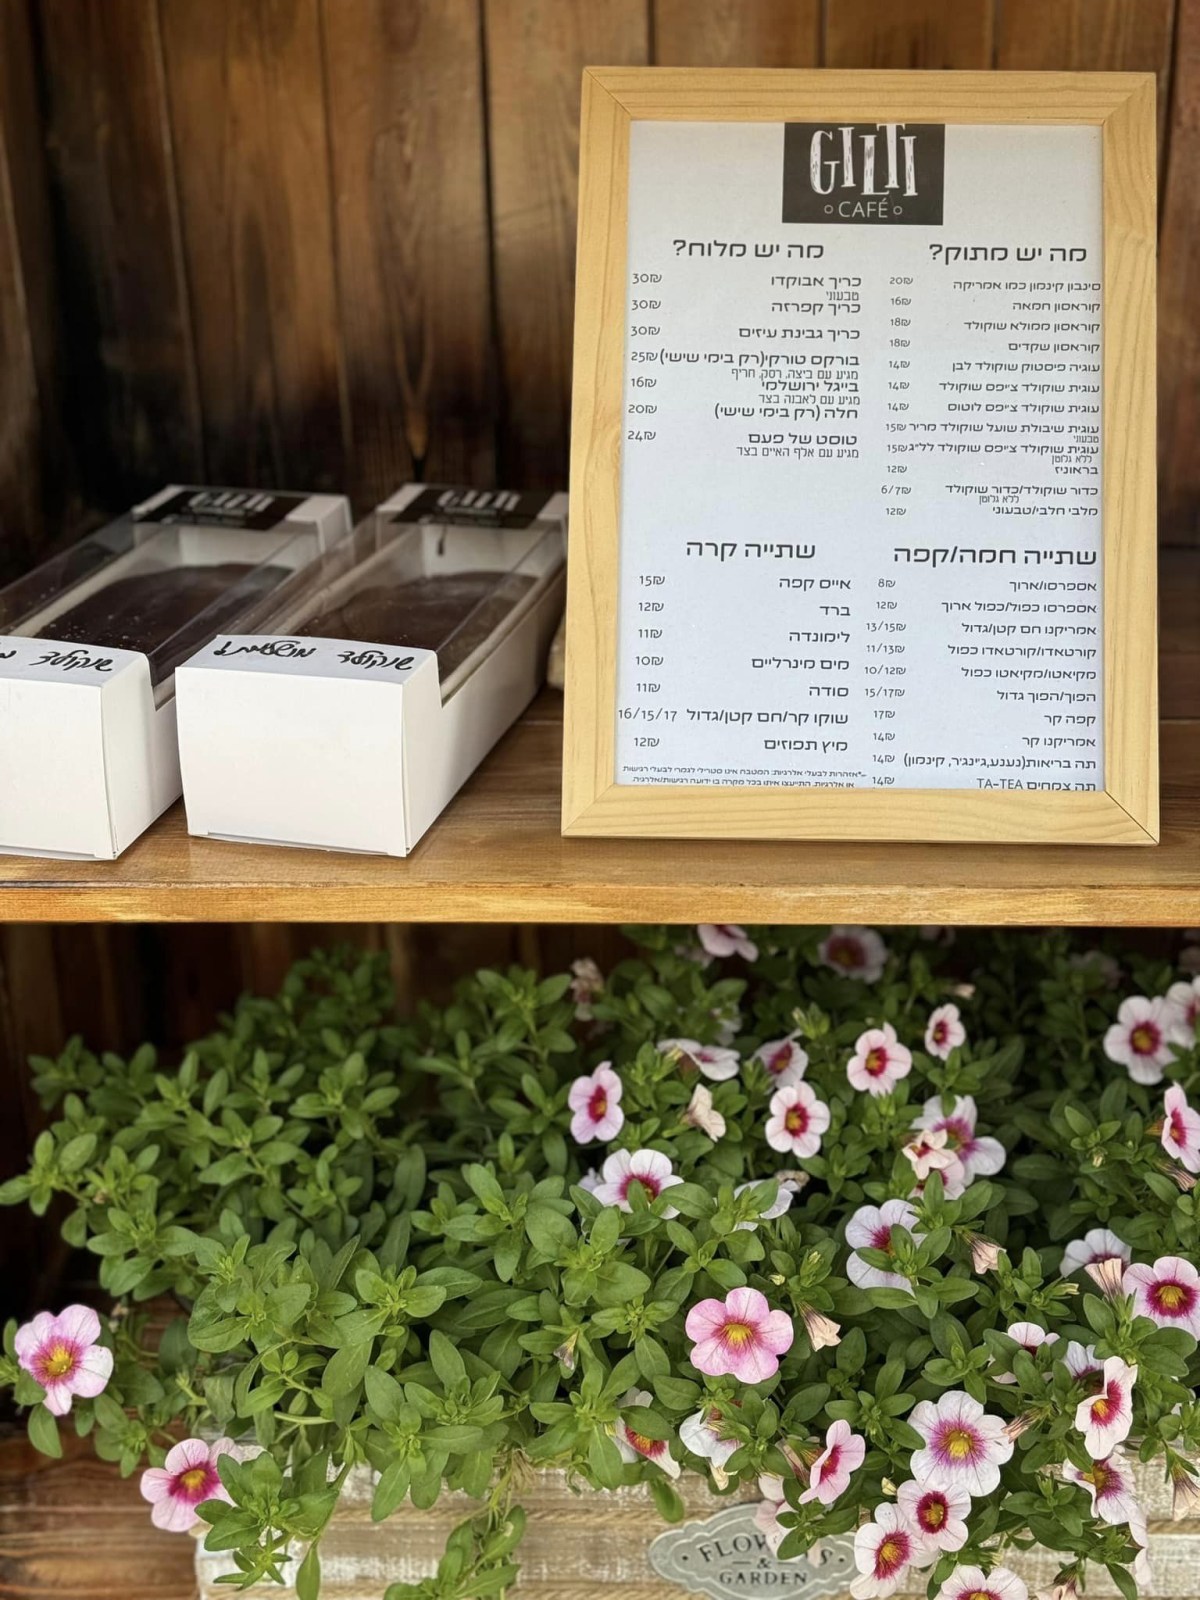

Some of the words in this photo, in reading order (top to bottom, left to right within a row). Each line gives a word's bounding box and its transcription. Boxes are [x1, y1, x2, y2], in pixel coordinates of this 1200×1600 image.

[810, 123, 918, 196] GILTI
[838, 198, 889, 218] CAFÉ
[673, 239, 746, 257] מלוח?
[754, 244, 780, 258] יש
[787, 244, 824, 259] מה
[929, 244, 1008, 266] מתוק?
[1016, 247, 1042, 261] יש
[1050, 248, 1087, 262] מה
[771, 276, 824, 289] אבוקדו
[828, 277, 862, 290] כריך
[953, 281, 1002, 292] אמריקה
[1005, 282, 1026, 290] כמו
[1029, 282, 1064, 293] קינמון
[1067, 283, 1101, 293] סינבון
[772, 302, 824, 316] קפרזה
[828, 303, 861, 316] כריך
[1012, 302, 1051, 311] חמאה
[1054, 303, 1101, 314] קוראסון
[964, 320, 1007, 332] שוקולד
[1010, 321, 1050, 331] ממולא
[1054, 323, 1101, 334] קוראסון
[738, 328, 777, 338] עיזים
[781, 329, 823, 339] גבינת
[827, 329, 860, 342] כריך
[1008, 343, 1050, 354] שקדים
[1054, 343, 1100, 354] קוראסון
[704, 353, 734, 364] בימי
[810, 355, 860, 368] בורקס
[952, 361, 972, 372] לבן
[975, 361, 1018, 373] שוקולד
[1021, 363, 1066, 374] פיסטוק
[1069, 364, 1100, 372] עוגיה
[762, 379, 820, 392] ירושלמי
[823, 380, 859, 392] בייגל
[939, 381, 982, 394] שוקולד
[1021, 382, 1065, 395] שוקולד
[1068, 384, 1100, 393] עוגית
[948, 402, 982, 412] לוטוס
[1021, 403, 1065, 415] שוקולד
[1068, 405, 1100, 414] עוגית
[759, 408, 790, 418] בימי
[824, 407, 858, 419] חלה
[909, 423, 937, 432] מריר
[940, 422, 984, 434] שוקולד
[986, 423, 1018, 433] שועל
[1020, 423, 1064, 433] שיבולת
[1067, 425, 1100, 434] עוגית
[748, 433, 784, 444] פעם
[788, 432, 812, 444] של
[816, 435, 857, 445] טוסט
[937, 443, 981, 454] שוקולד
[1020, 444, 1064, 456] שוקולד
[1067, 446, 1099, 454] עוגית
[1054, 466, 1099, 475] בראוניז
[945, 484, 988, 496] שוקולד
[1070, 487, 1098, 496] כדור
[1068, 506, 1098, 516] מלבי
[686, 542, 738, 562] קרה
[745, 543, 816, 559] שתייה
[1024, 550, 1096, 565] שתייה
[779, 578, 815, 592] קפה
[819, 579, 851, 590] אייס
[819, 606, 851, 616] ברד
[941, 602, 971, 613] ארוך
[1044, 604, 1097, 614] אספרסו
[1020, 625, 1041, 634] חם
[1045, 626, 1097, 637] אמריקנו
[789, 631, 850, 643] לימונדה
[947, 644, 978, 655] כפול
[751, 656, 816, 669] מינרליים
[820, 660, 850, 670] מים
[961, 667, 992, 678] כפול
[809, 686, 849, 697] סודה
[996, 690, 1024, 700] גדול
[618, 707, 678, 722] 16/15/17
[814, 714, 848, 727] שוקו
[1044, 715, 1062, 726] קר
[1066, 715, 1096, 727] קפה
[764, 740, 818, 751] תפוזים
[822, 741, 848, 754] מיץ
[1022, 737, 1040, 748] קר
[1044, 737, 1096, 749] אמריקנו
[1075, 760, 1096, 769] תה
[976, 778, 1023, 790] TA-TEA
[757, 1557, 771, 1570] &
[719, 1572, 807, 1585] GARDEN
